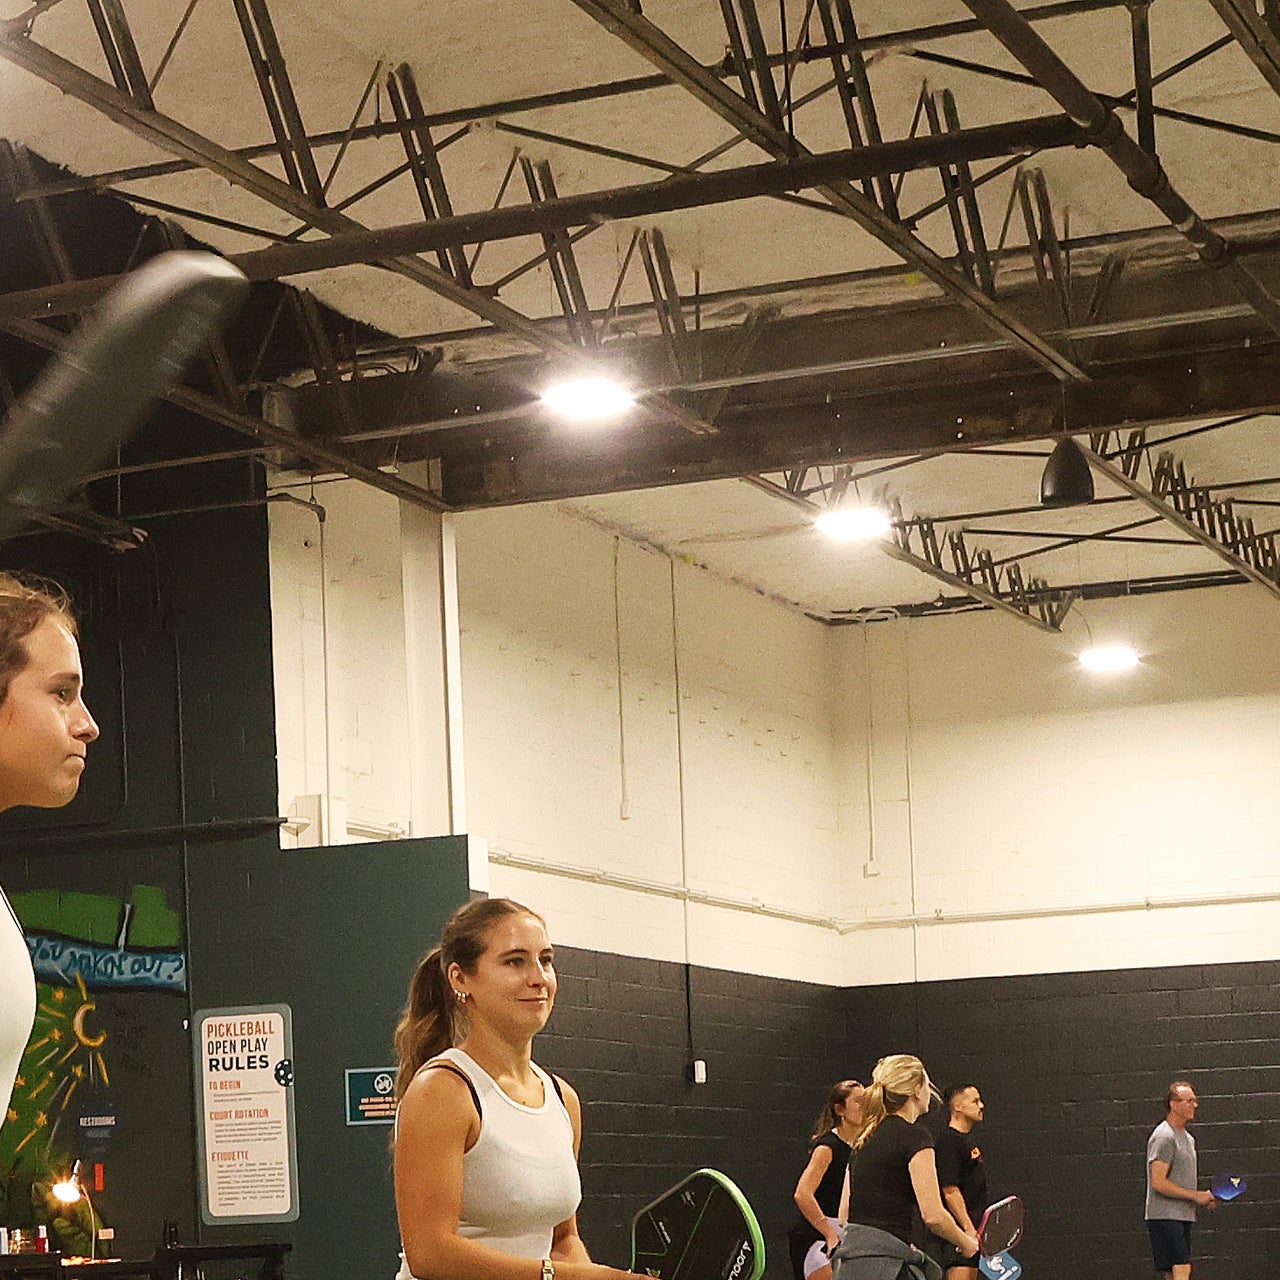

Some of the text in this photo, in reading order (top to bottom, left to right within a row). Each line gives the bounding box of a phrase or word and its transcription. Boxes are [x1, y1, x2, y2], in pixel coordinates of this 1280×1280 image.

[130, 953, 185, 981] OUT?
[207, 1020, 275, 1038] PICKLEBALL
[207, 1037, 268, 1055] OPEN PLAY
[209, 1055, 269, 1072] RULES
